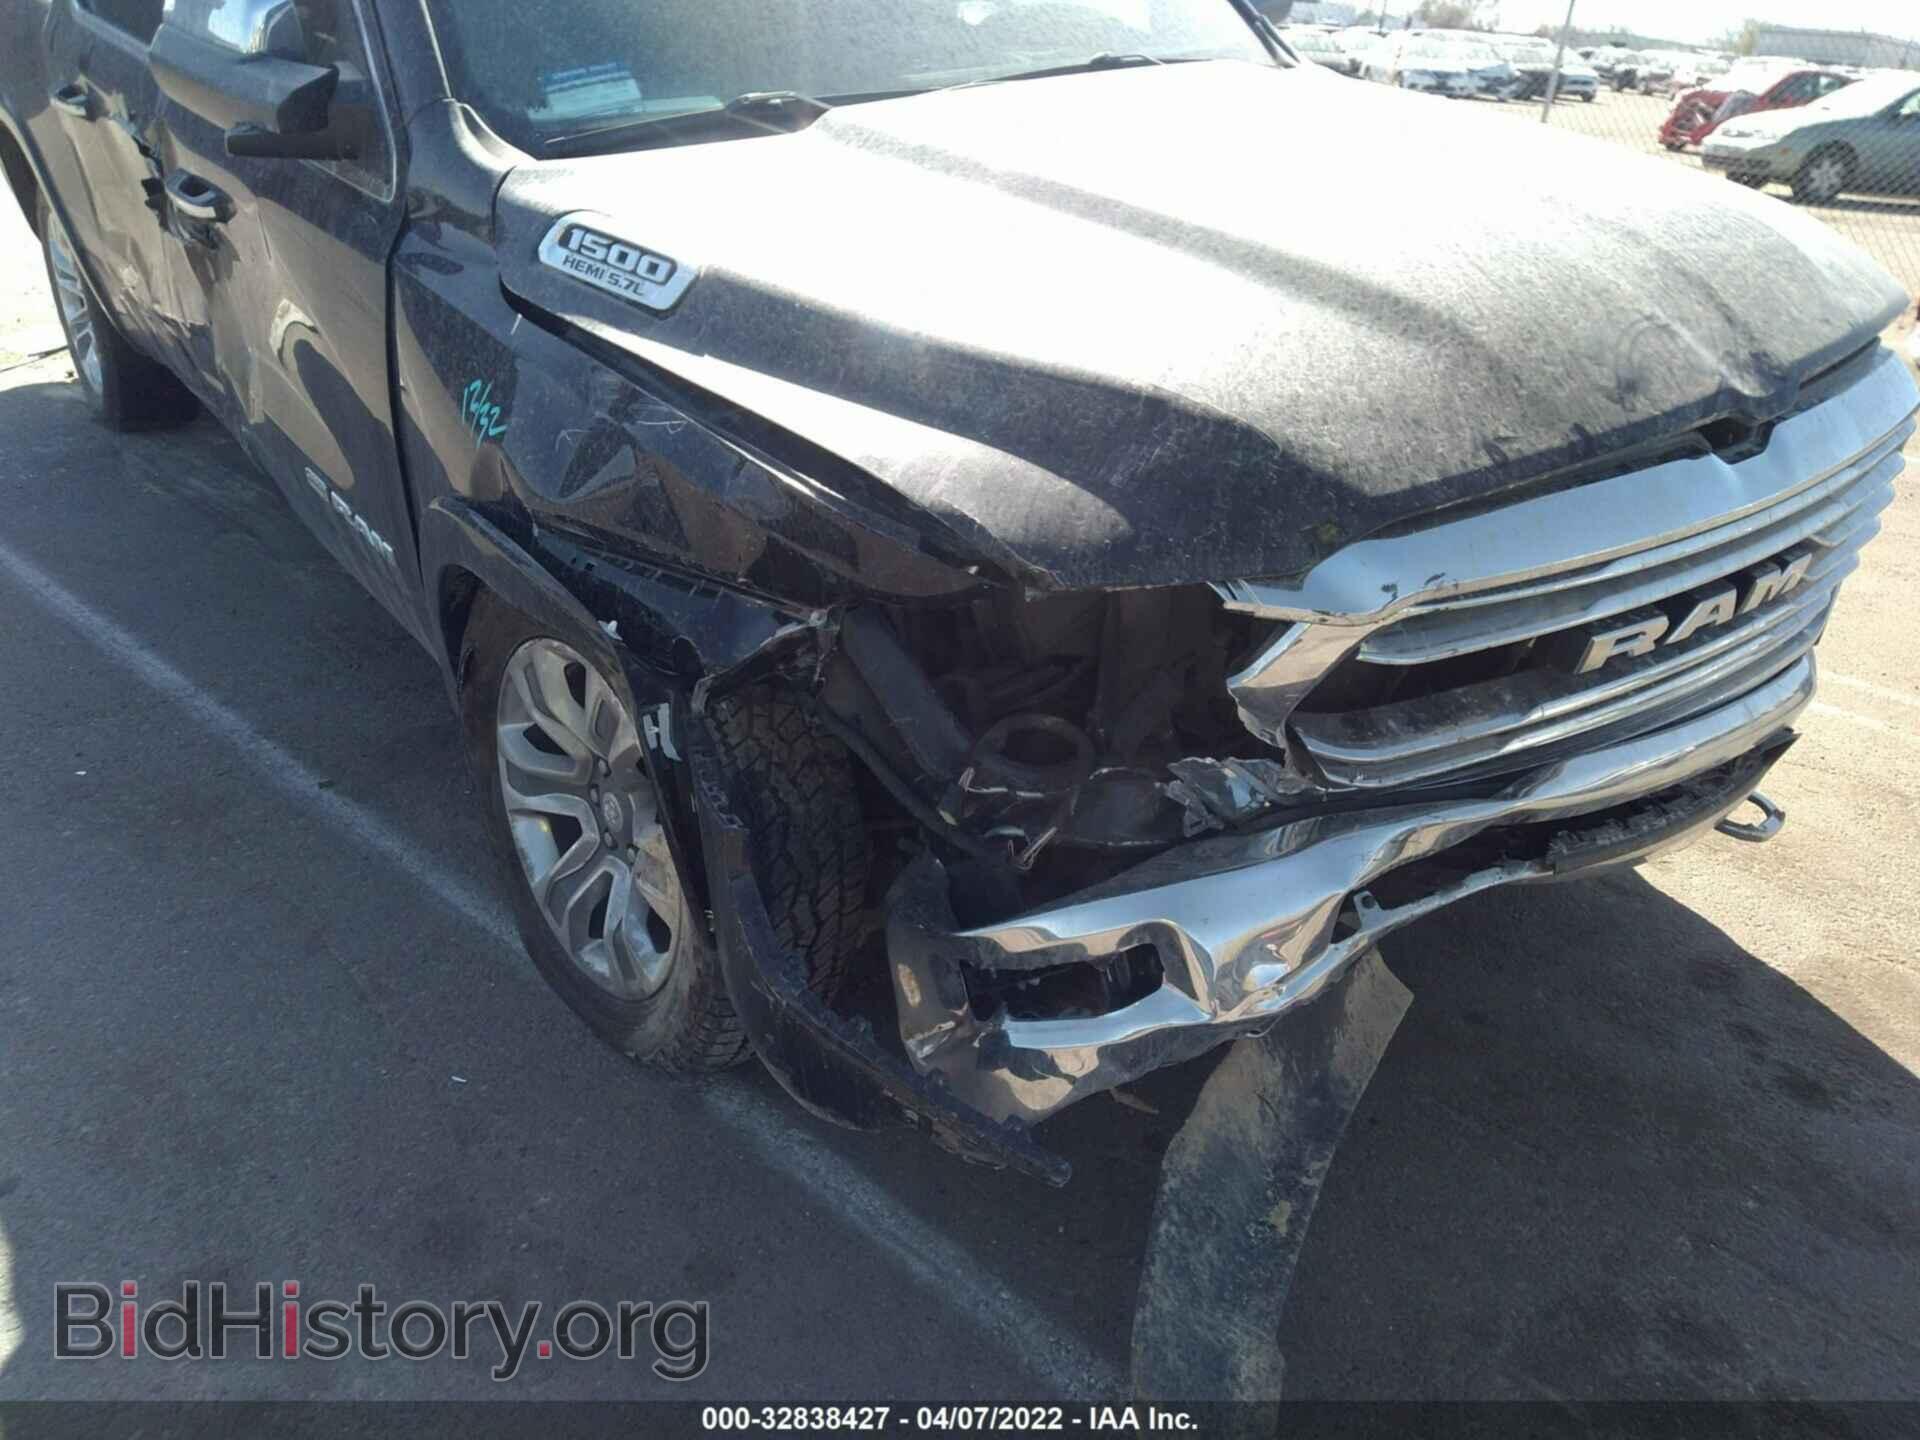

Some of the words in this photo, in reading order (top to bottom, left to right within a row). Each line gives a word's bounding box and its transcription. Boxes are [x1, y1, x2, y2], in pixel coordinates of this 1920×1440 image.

[562, 254, 606, 280] HEMI
[607, 271, 646, 296] 5.7L
[568, 228, 673, 283] 1500
[1574, 552, 1812, 674] RAM
